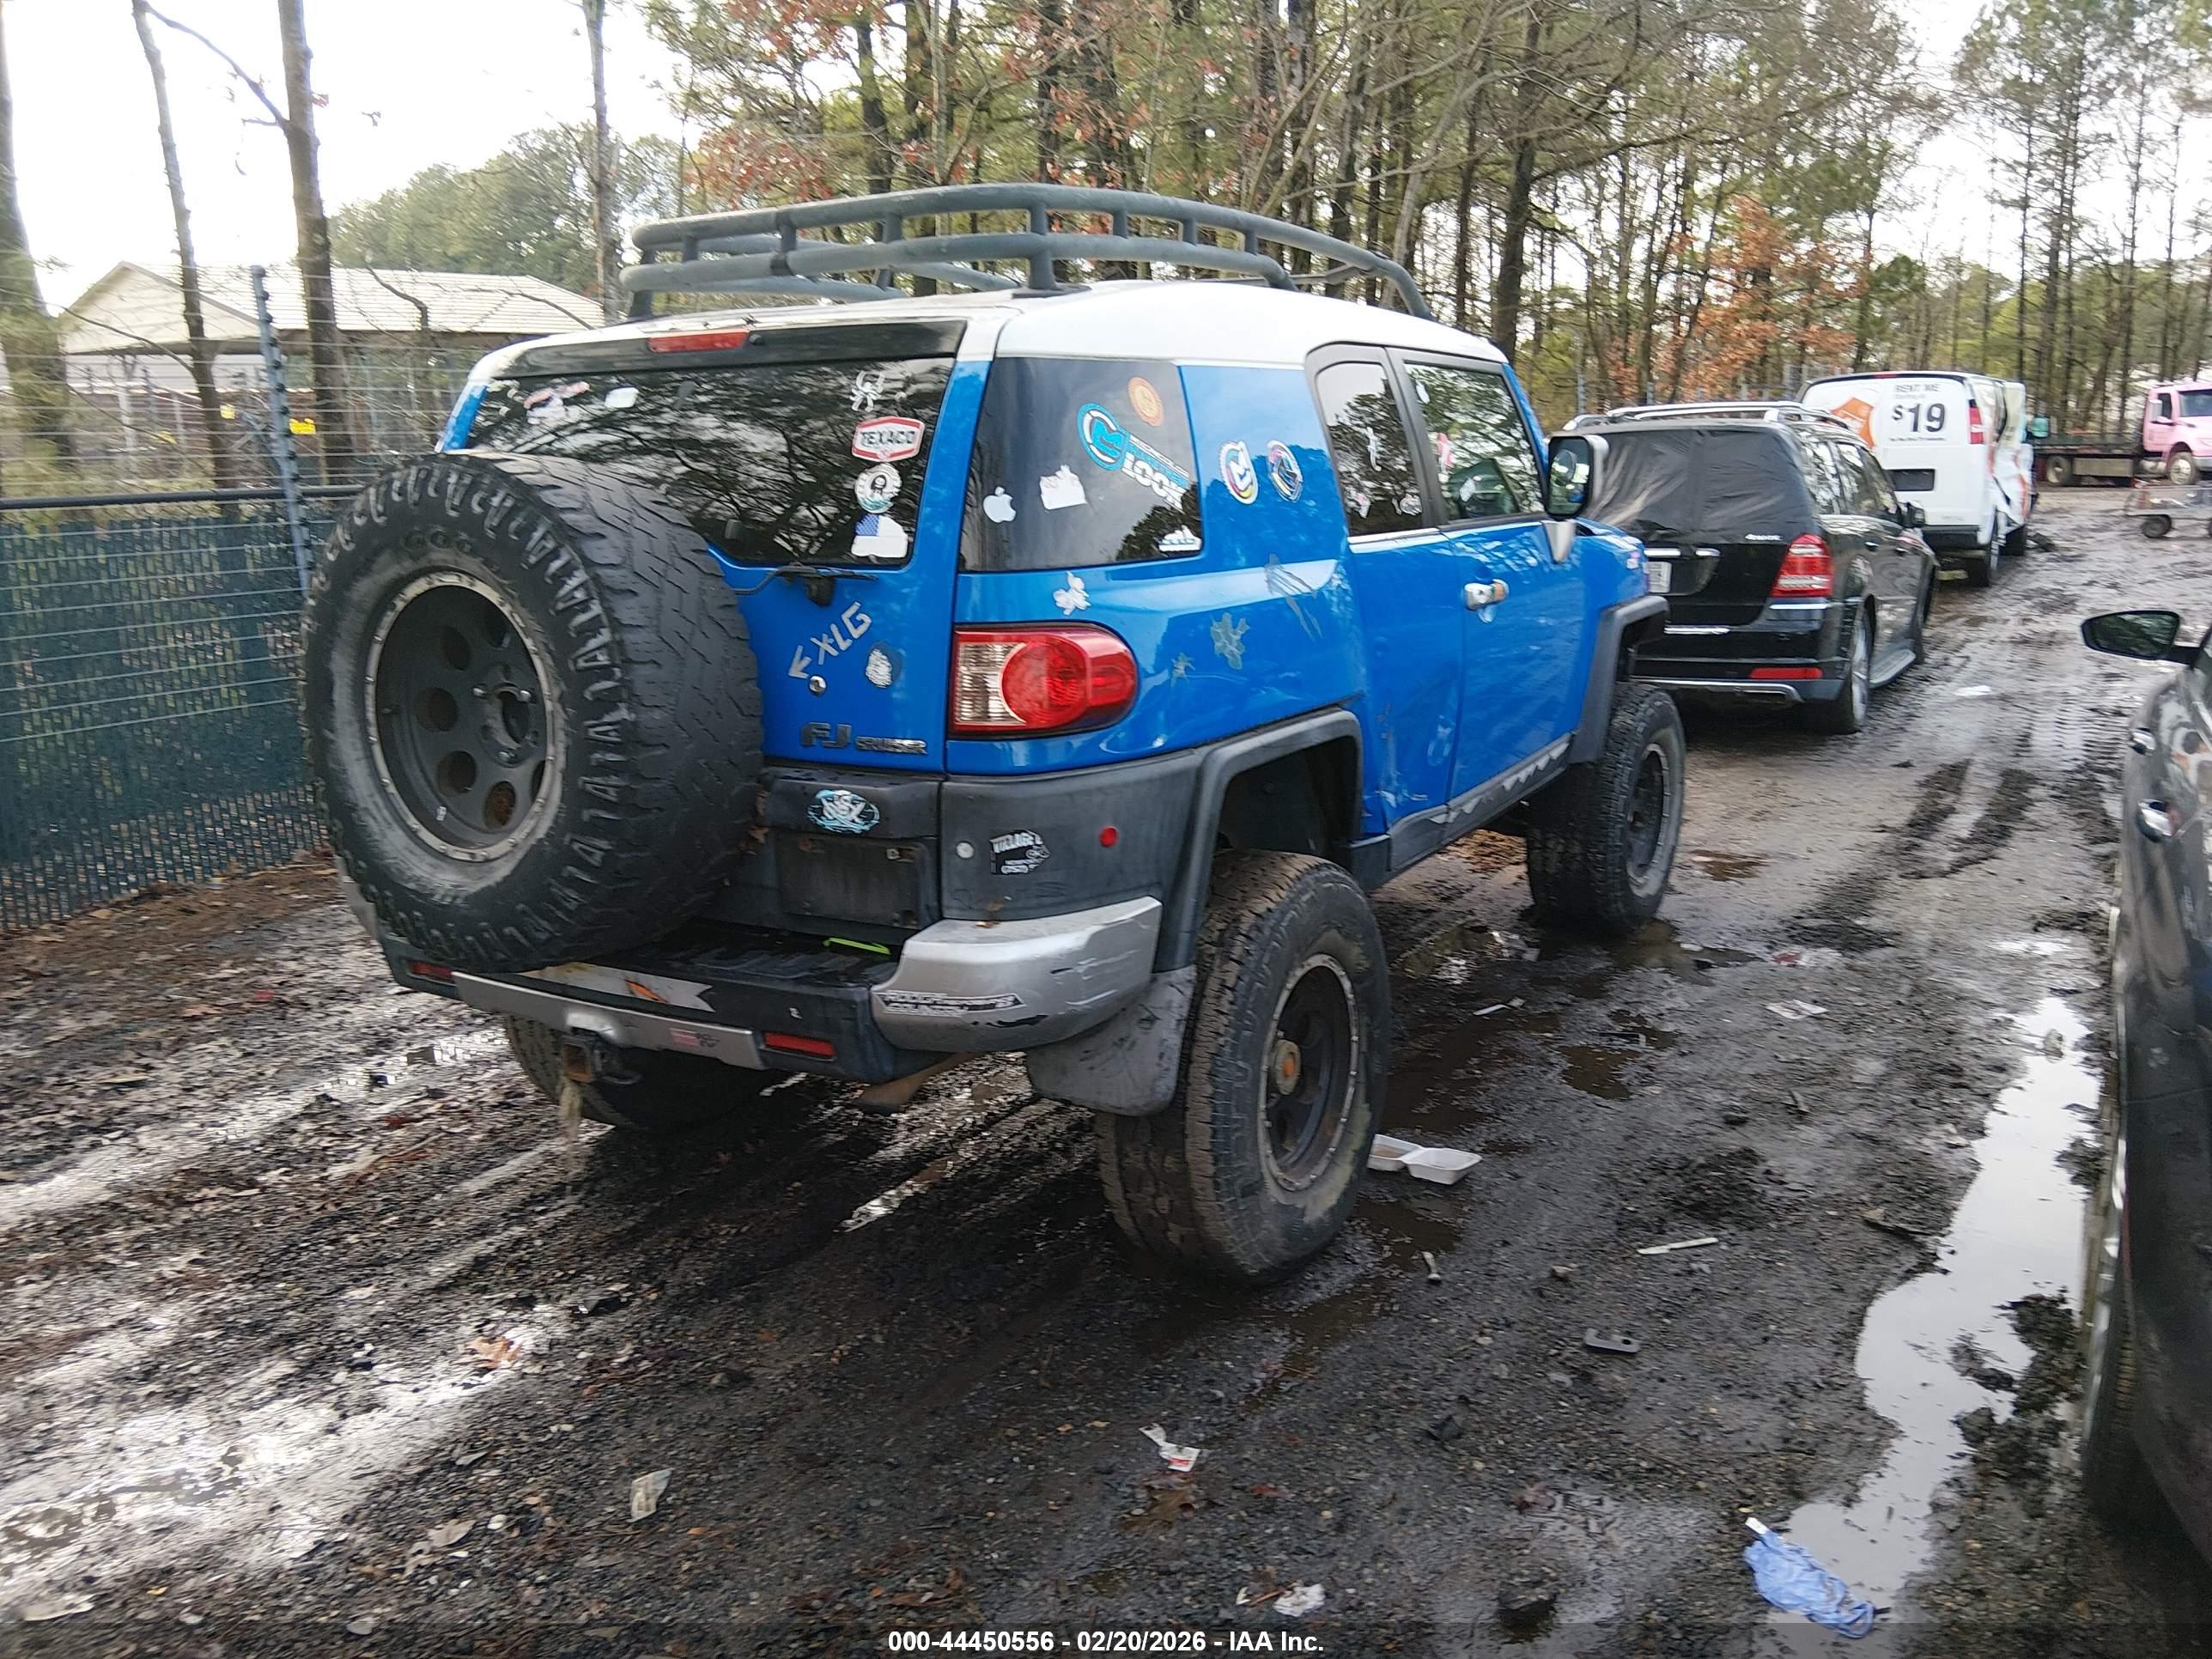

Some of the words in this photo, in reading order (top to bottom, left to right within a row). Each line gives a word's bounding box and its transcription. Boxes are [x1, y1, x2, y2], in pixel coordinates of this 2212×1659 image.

[1892, 404, 1946, 432] $19
[860, 429, 917, 448] TEXACO
[801, 722, 852, 748] FJ
